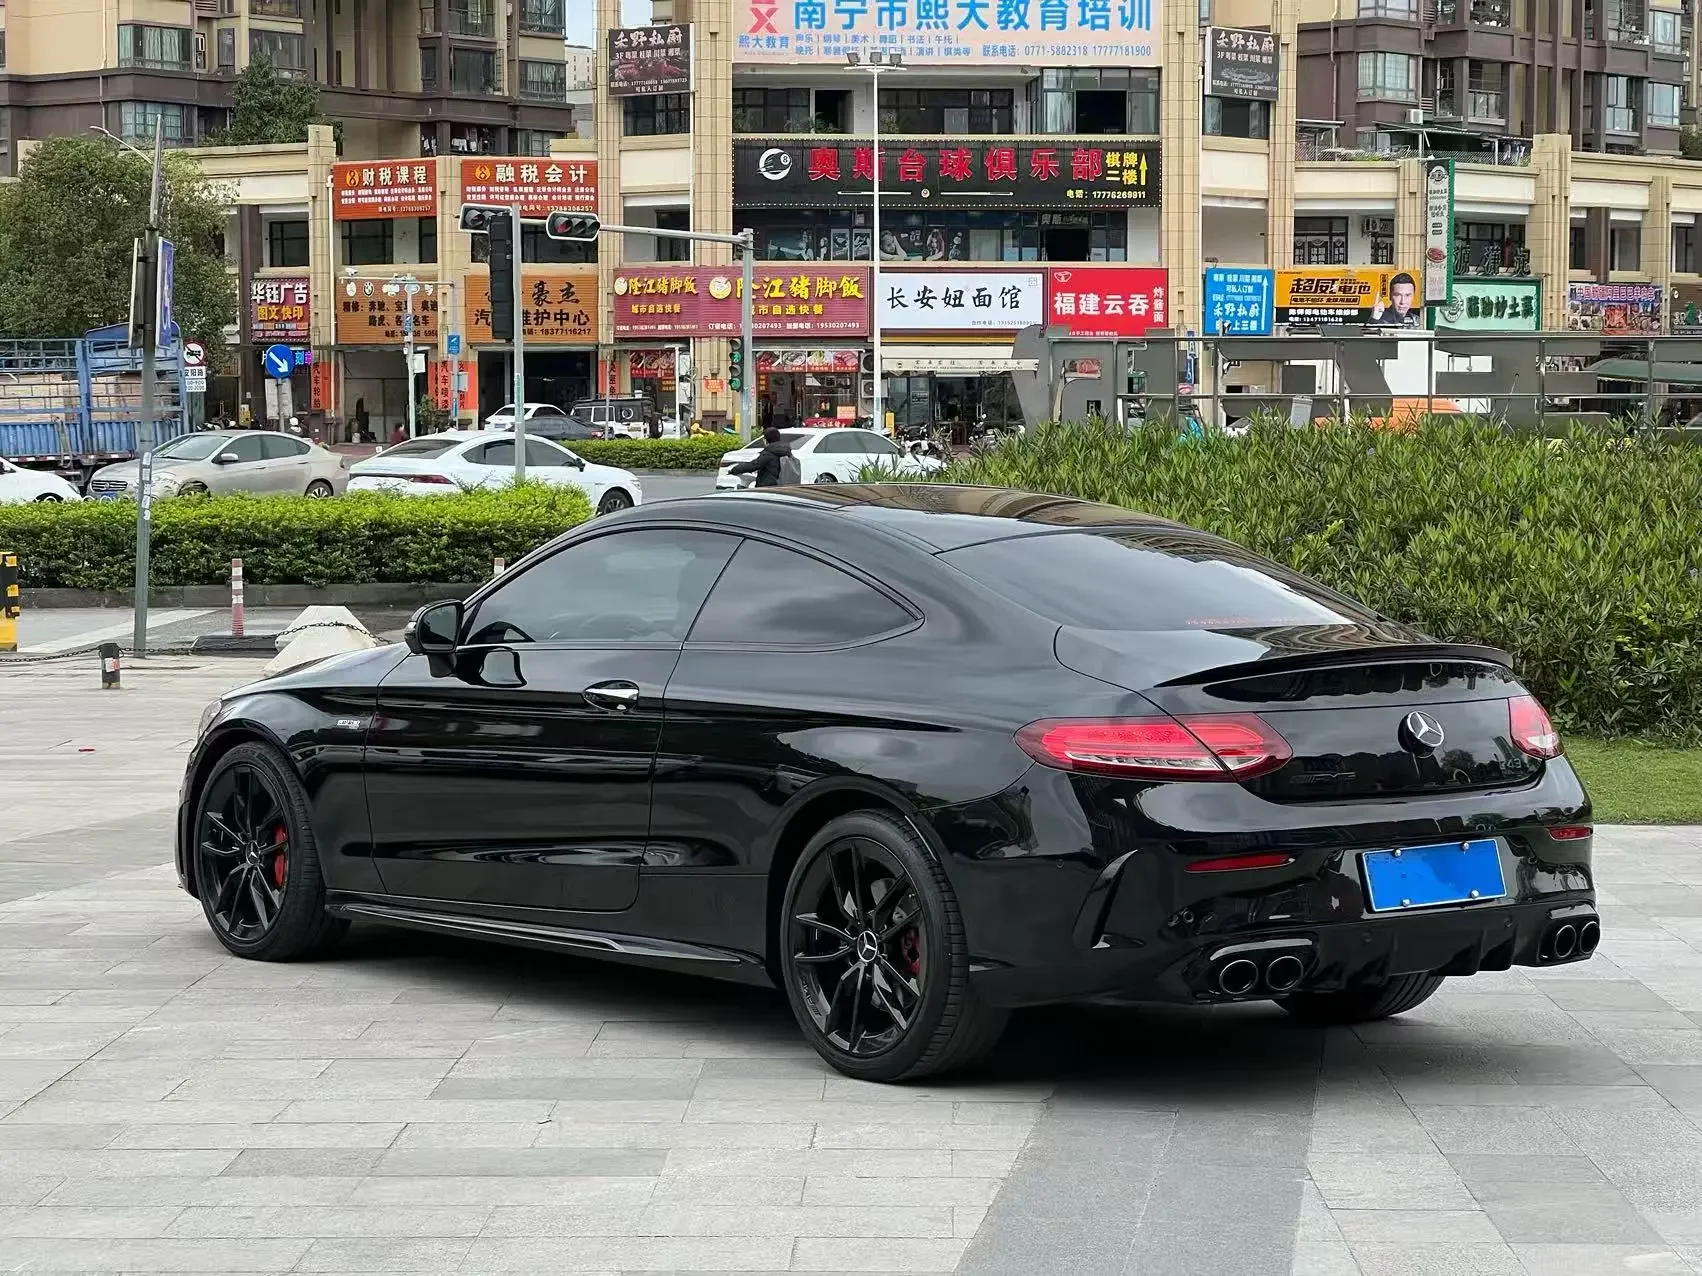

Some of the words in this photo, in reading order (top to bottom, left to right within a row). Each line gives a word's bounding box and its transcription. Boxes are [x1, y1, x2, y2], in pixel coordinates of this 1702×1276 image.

[794, 0, 1150, 30] 南宁市熙大教育培训
[738, 35, 789, 48] 熙大教育
[808, 146, 1103, 182] 奥斯台球俱乐部
[1106, 152, 1138, 168] 棋牌
[362, 166, 427, 186] 财税课程
[495, 164, 588, 183] 融税会计
[1106, 169, 1138, 185] 二楼
[1290, 278, 1371, 295] 超威电池
[887, 285, 1022, 309] 长安妞面馆
[1054, 292, 1149, 316] 福建云吞
[1153, 287, 1164, 323] 炸酱面
